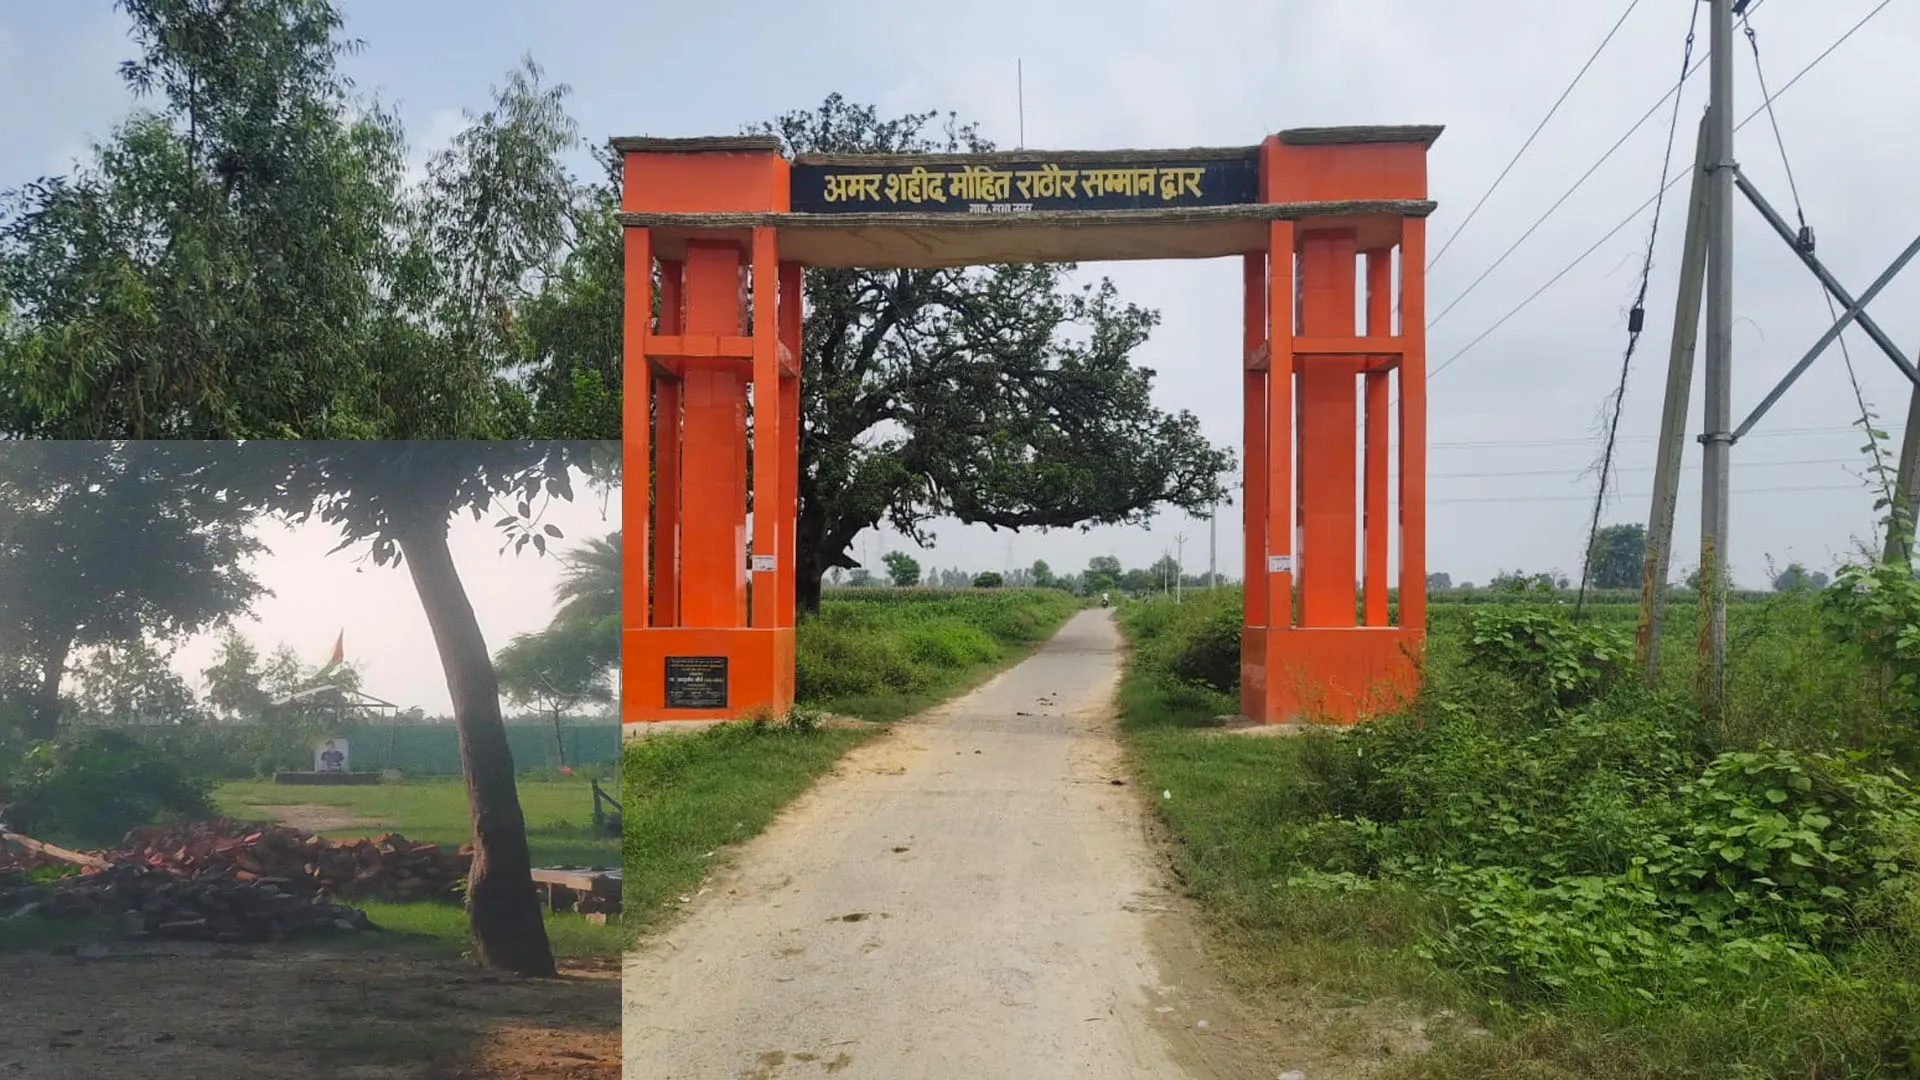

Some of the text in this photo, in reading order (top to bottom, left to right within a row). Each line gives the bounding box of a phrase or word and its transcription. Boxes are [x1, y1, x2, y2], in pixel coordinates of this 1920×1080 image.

[824, 174, 883, 202] अमर
[884, 166, 947, 203] शहीद
[948, 165, 1013, 201] मोहित
[1081, 167, 1158, 198] सम्मान
[1159, 167, 1206, 200] द्वार
